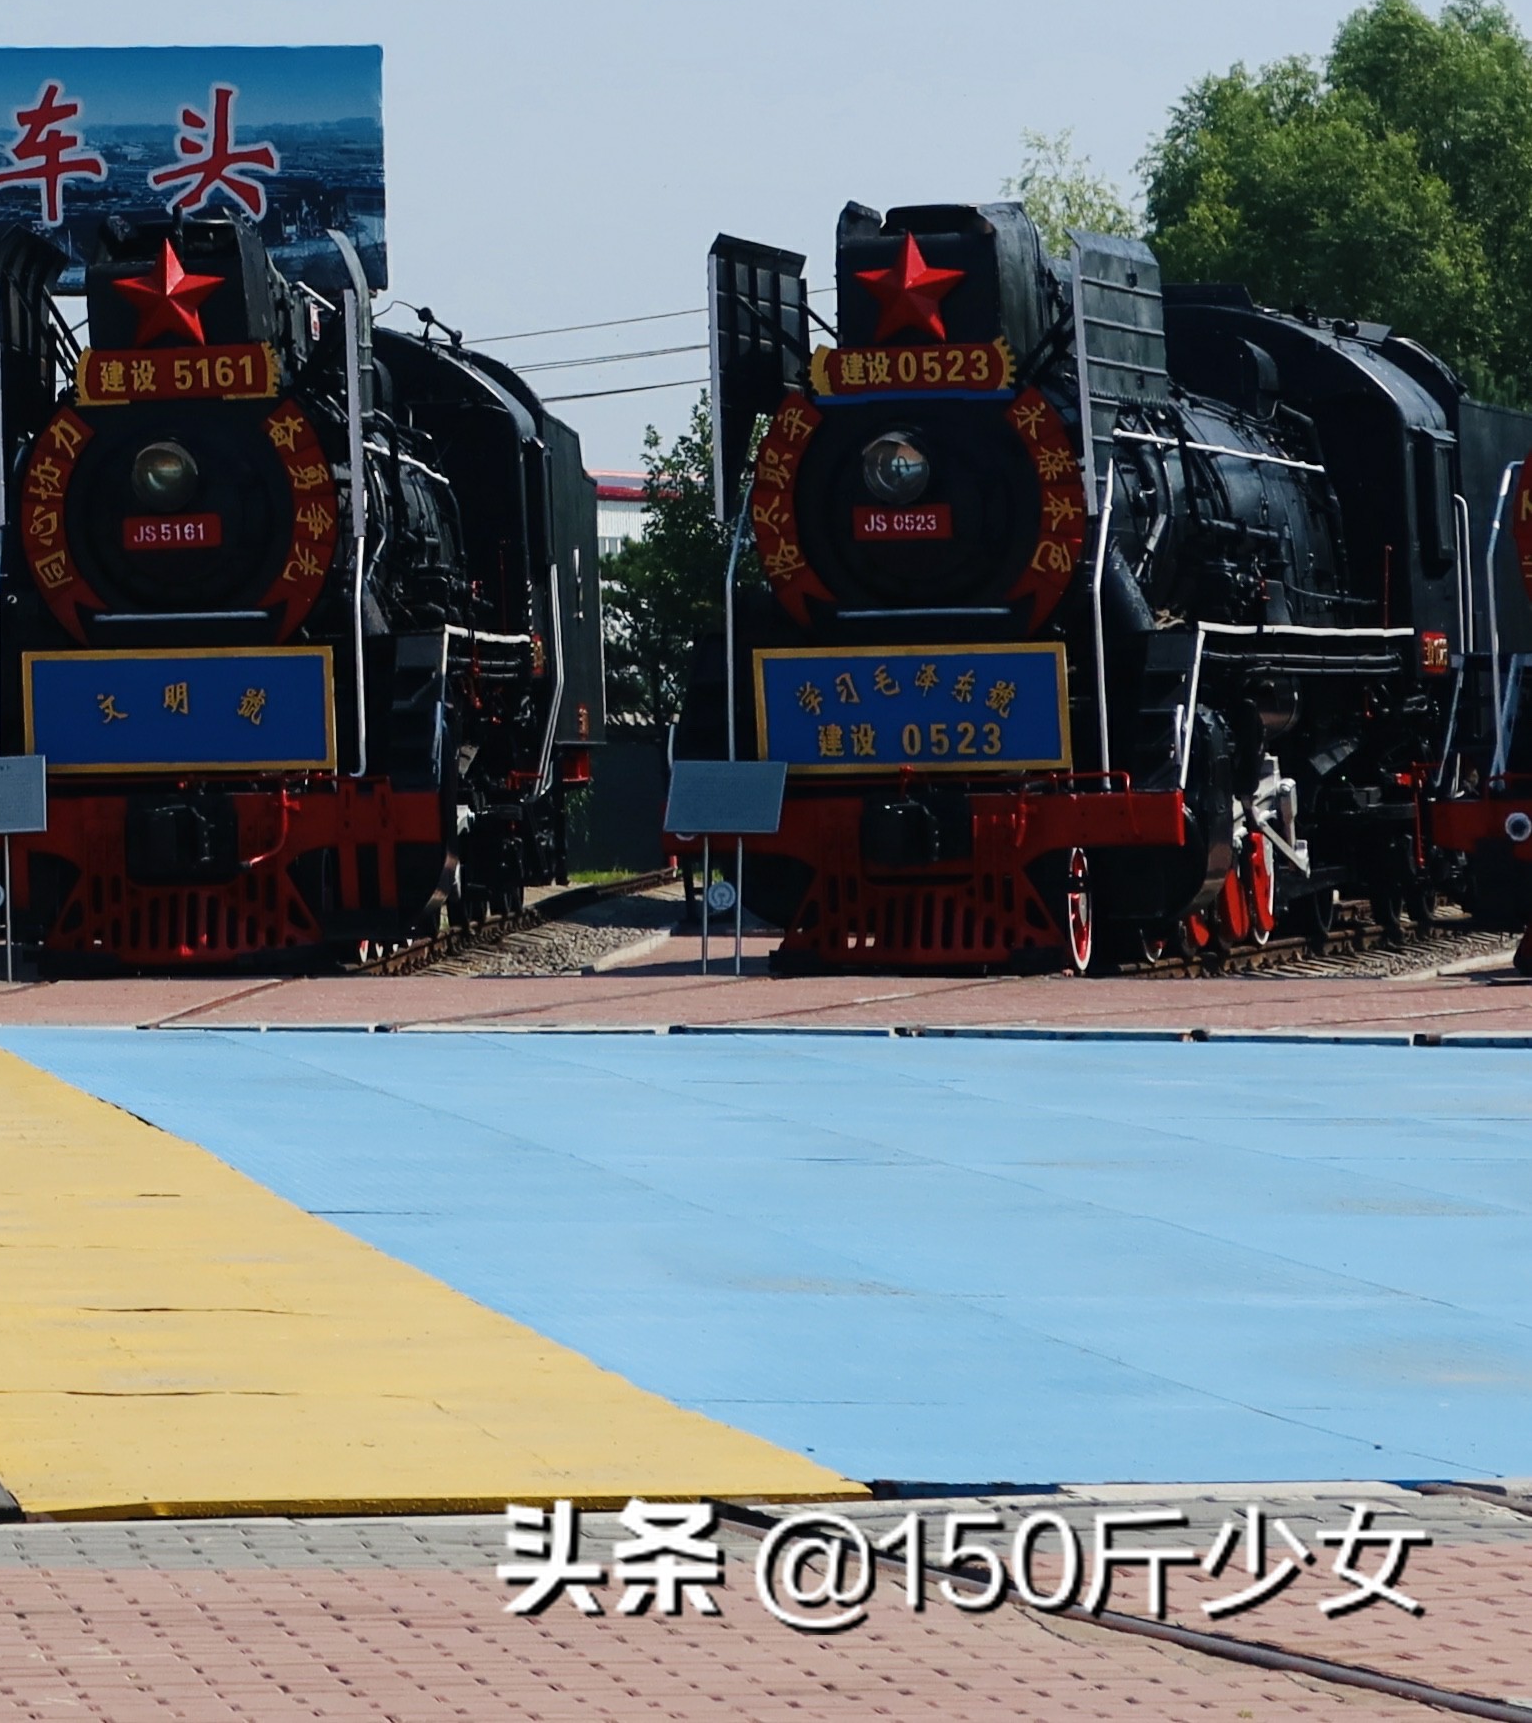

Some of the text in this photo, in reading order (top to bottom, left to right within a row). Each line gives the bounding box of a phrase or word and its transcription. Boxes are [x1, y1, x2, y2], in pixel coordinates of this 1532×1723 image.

[100, 355, 253, 393] 建设 5161
[840, 350, 989, 385] 建设 0523
[269, 415, 333, 581] 奋勇争先
[1014, 403, 1082, 573] 永葆本色
[134, 523, 205, 542] JS 5161
[865, 515, 937, 531] JS 0523
[818, 722, 1002, 757] 建设 0523
